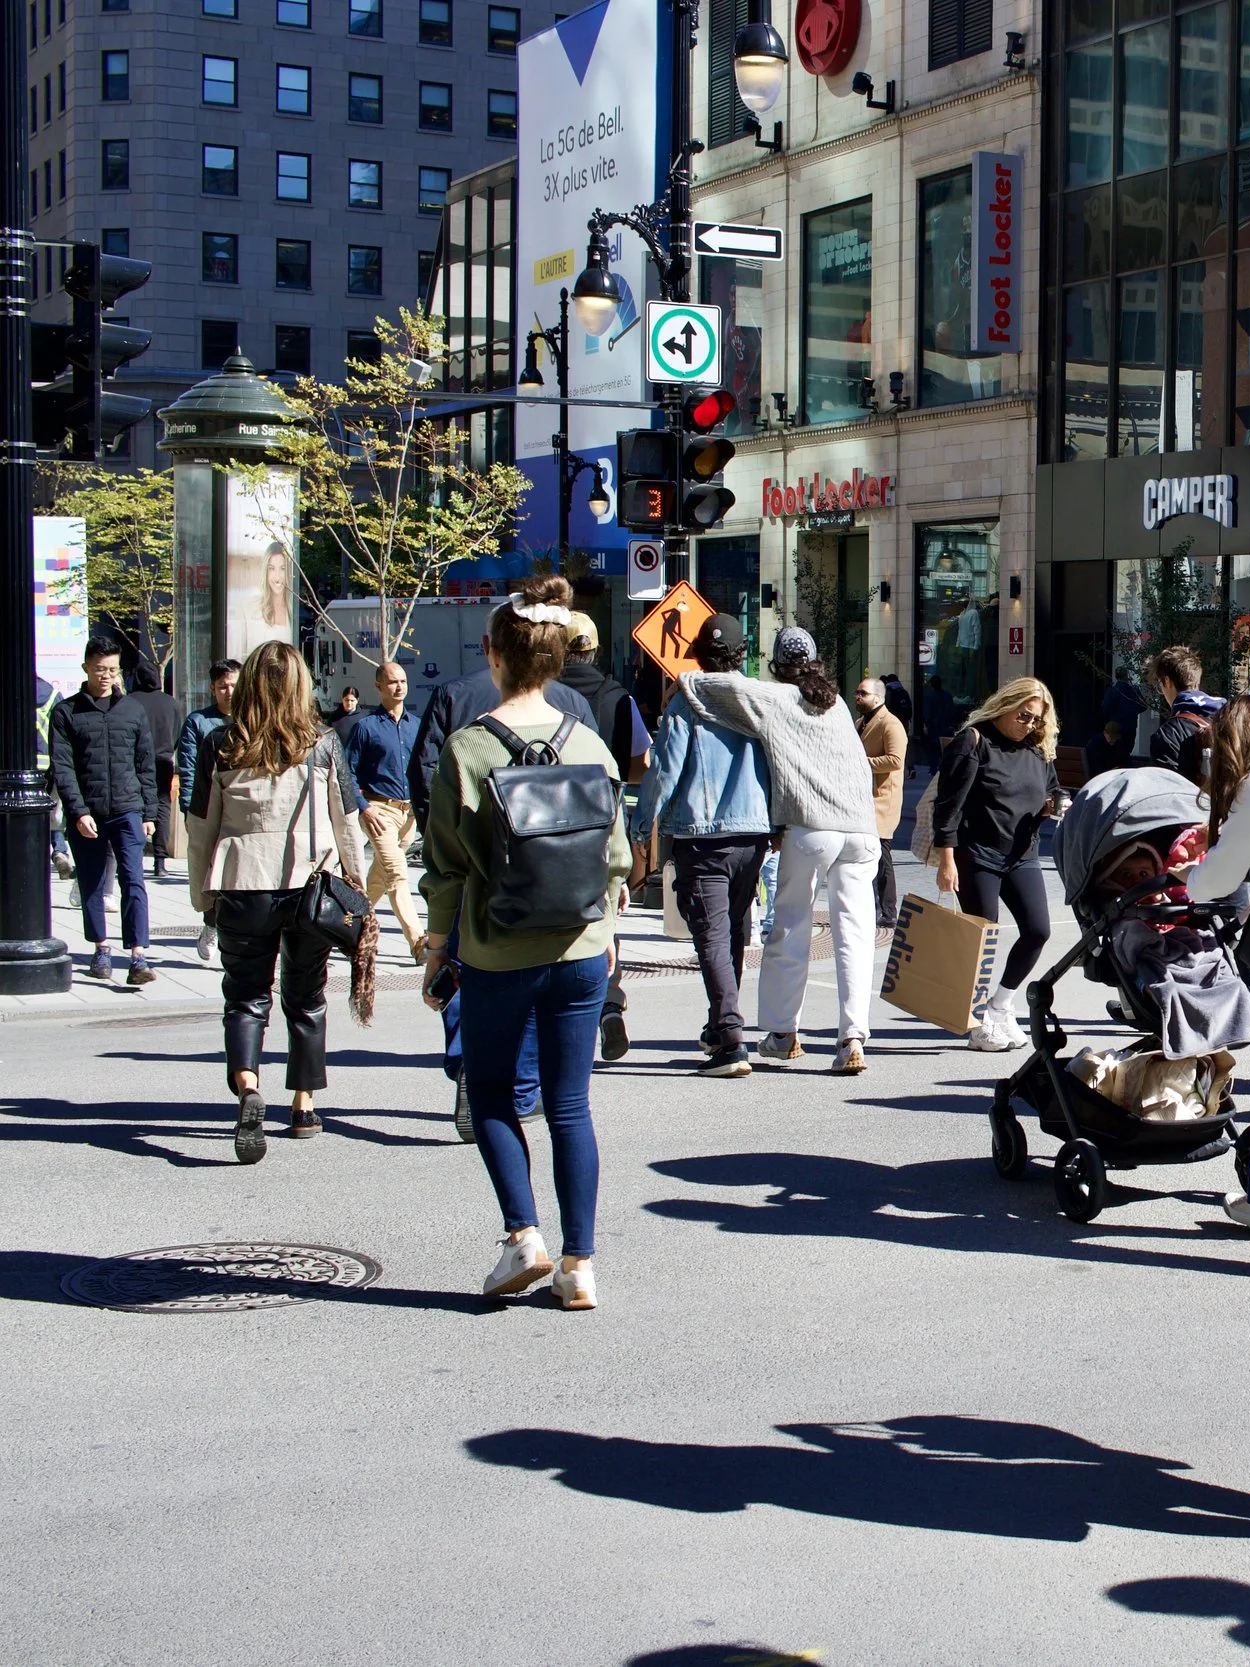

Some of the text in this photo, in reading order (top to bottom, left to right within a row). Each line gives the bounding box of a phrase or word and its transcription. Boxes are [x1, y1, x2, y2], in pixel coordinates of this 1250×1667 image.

[540, 105, 624, 164] La 5G de Bell.
[543, 155, 618, 203] 3X plus vite.
[540, 256, 567, 279] L'AUTRE
[989, 163, 1012, 342] Foot Locker
[238, 422, 258, 436] Rue
[762, 467, 893, 517] Foot Locker
[1143, 474, 1233, 530] CAMPER
